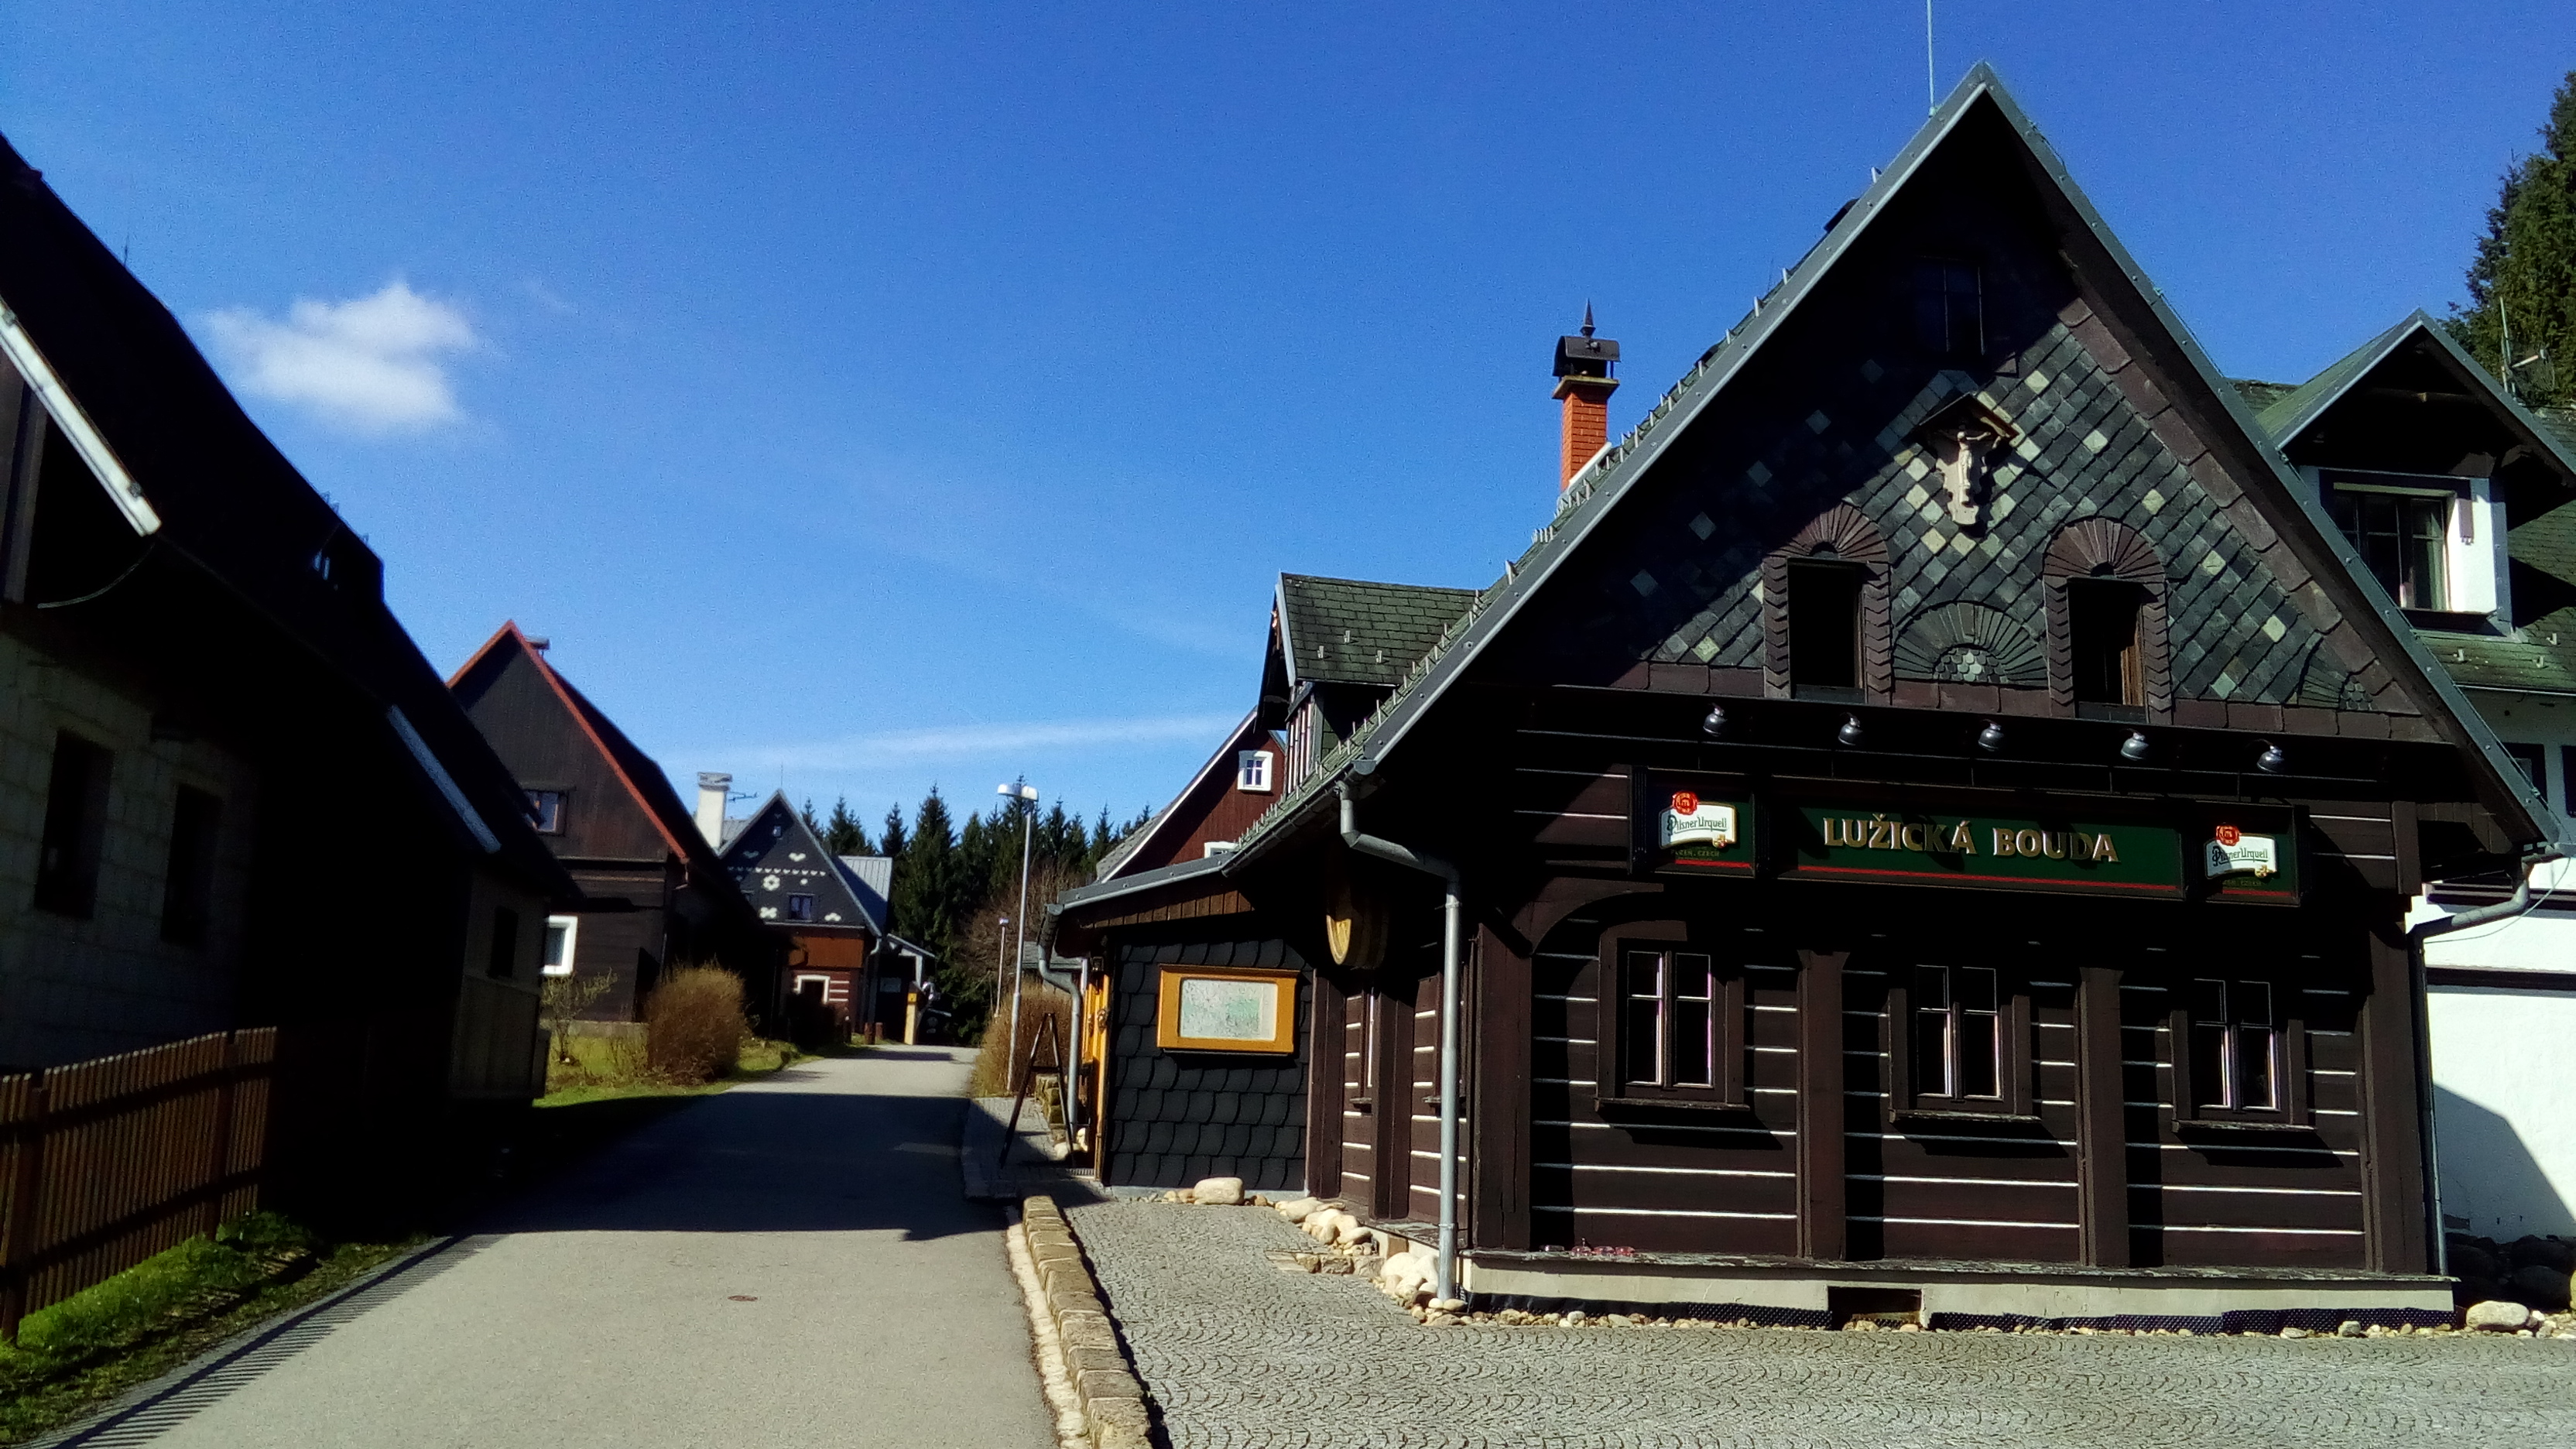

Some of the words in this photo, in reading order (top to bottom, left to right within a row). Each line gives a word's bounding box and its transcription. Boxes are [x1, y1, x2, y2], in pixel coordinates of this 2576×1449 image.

[1667, 814, 1697, 836] Pilsner
[1697, 815, 1726, 831] Urquell
[1823, 813, 1978, 855] LUŽICKÁ
[1993, 827, 2120, 862] BOUDA
[2240, 847, 2268, 862] Urquell
